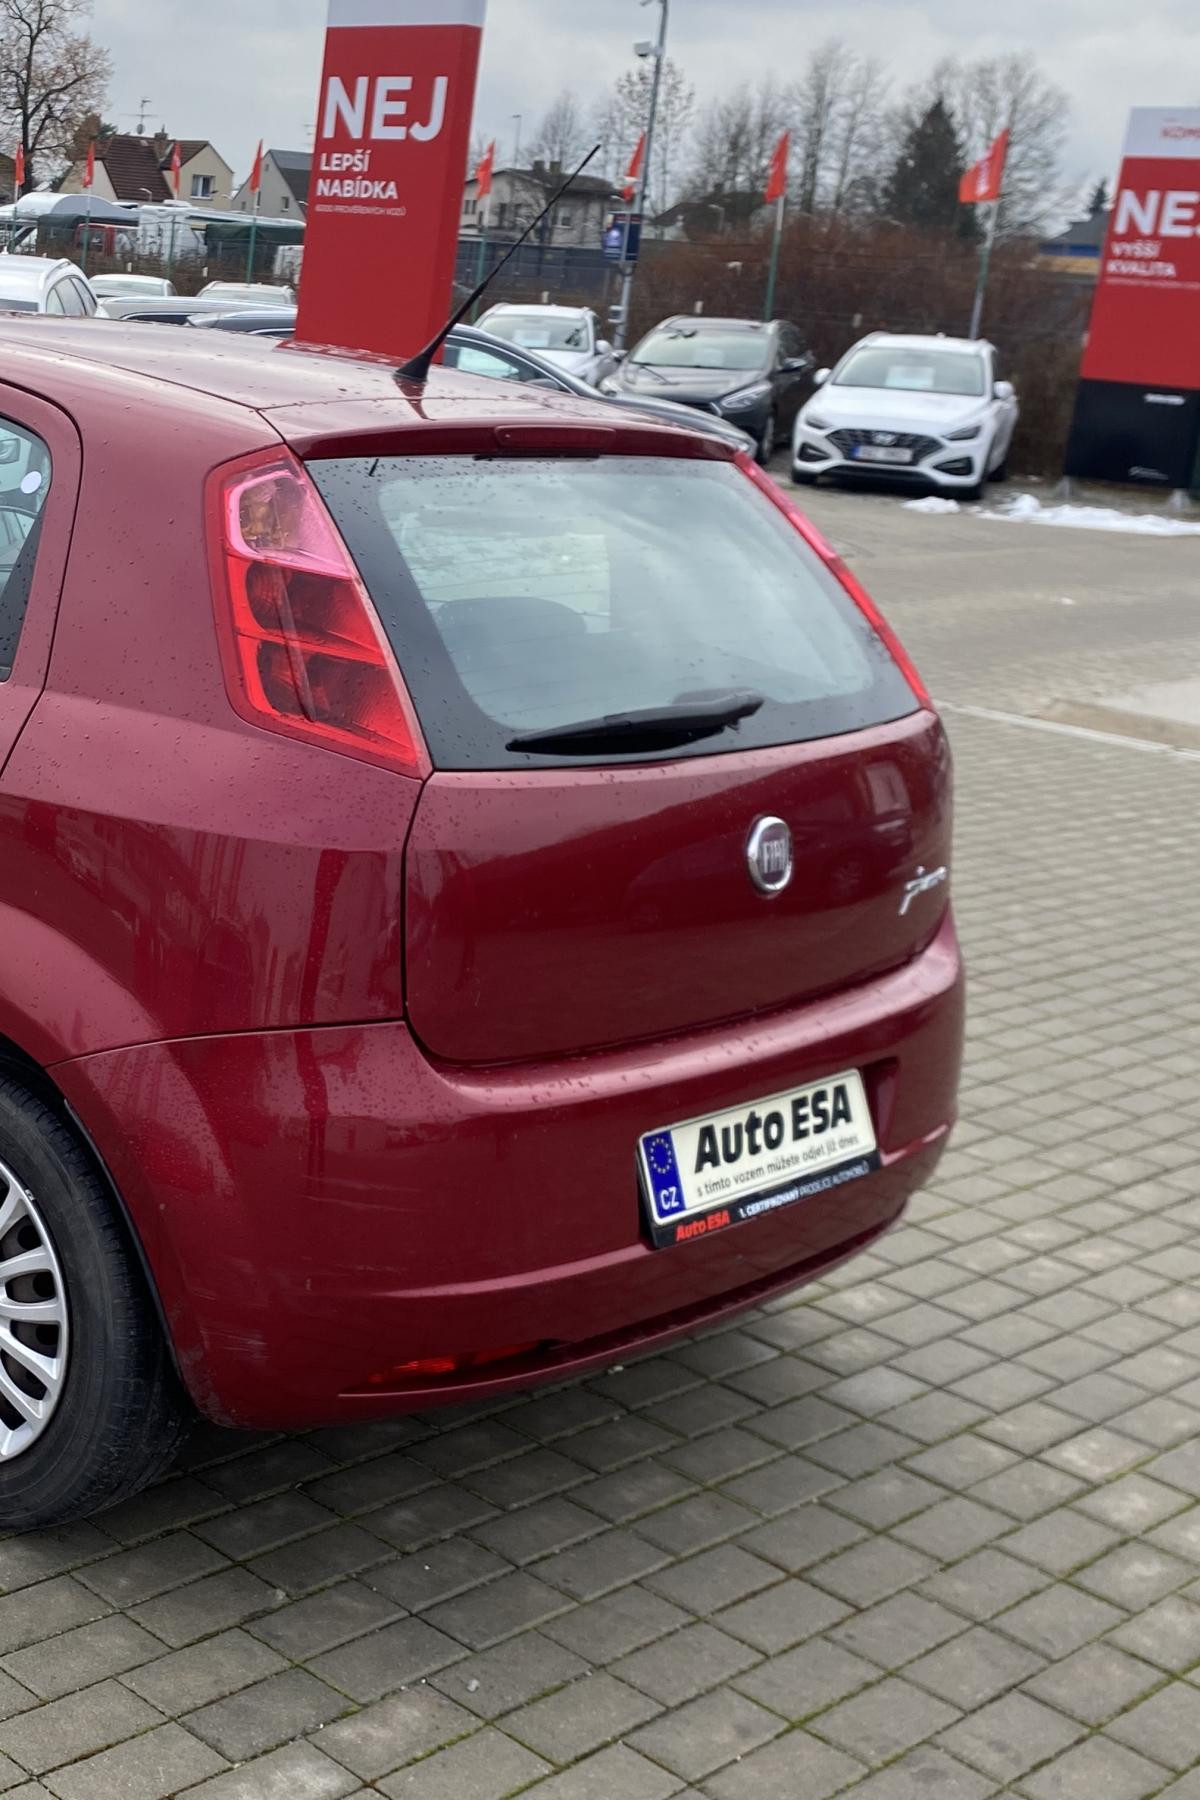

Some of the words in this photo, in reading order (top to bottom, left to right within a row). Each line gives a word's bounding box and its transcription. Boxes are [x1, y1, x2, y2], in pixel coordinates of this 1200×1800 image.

[322, 76, 448, 141] NEJ
[320, 149, 372, 172] LEPŠÍ
[316, 176, 398, 200] NABÍDKA
[1114, 189, 1200, 237] NE
[694, 1111, 785, 1174] Auto
[791, 1084, 853, 1142] ESA
[704, 1176, 731, 1195] tímto
[734, 1166, 765, 1184] vozem
[767, 1154, 800, 1177] můžete
[803, 1144, 826, 1162] odjet
[827, 1140, 838, 1157] již
[839, 1135, 859, 1151] dnes
[660, 1187, 680, 1211] CZ
[676, 1218, 707, 1241] Auto
[707, 1210, 730, 1231] ESA
